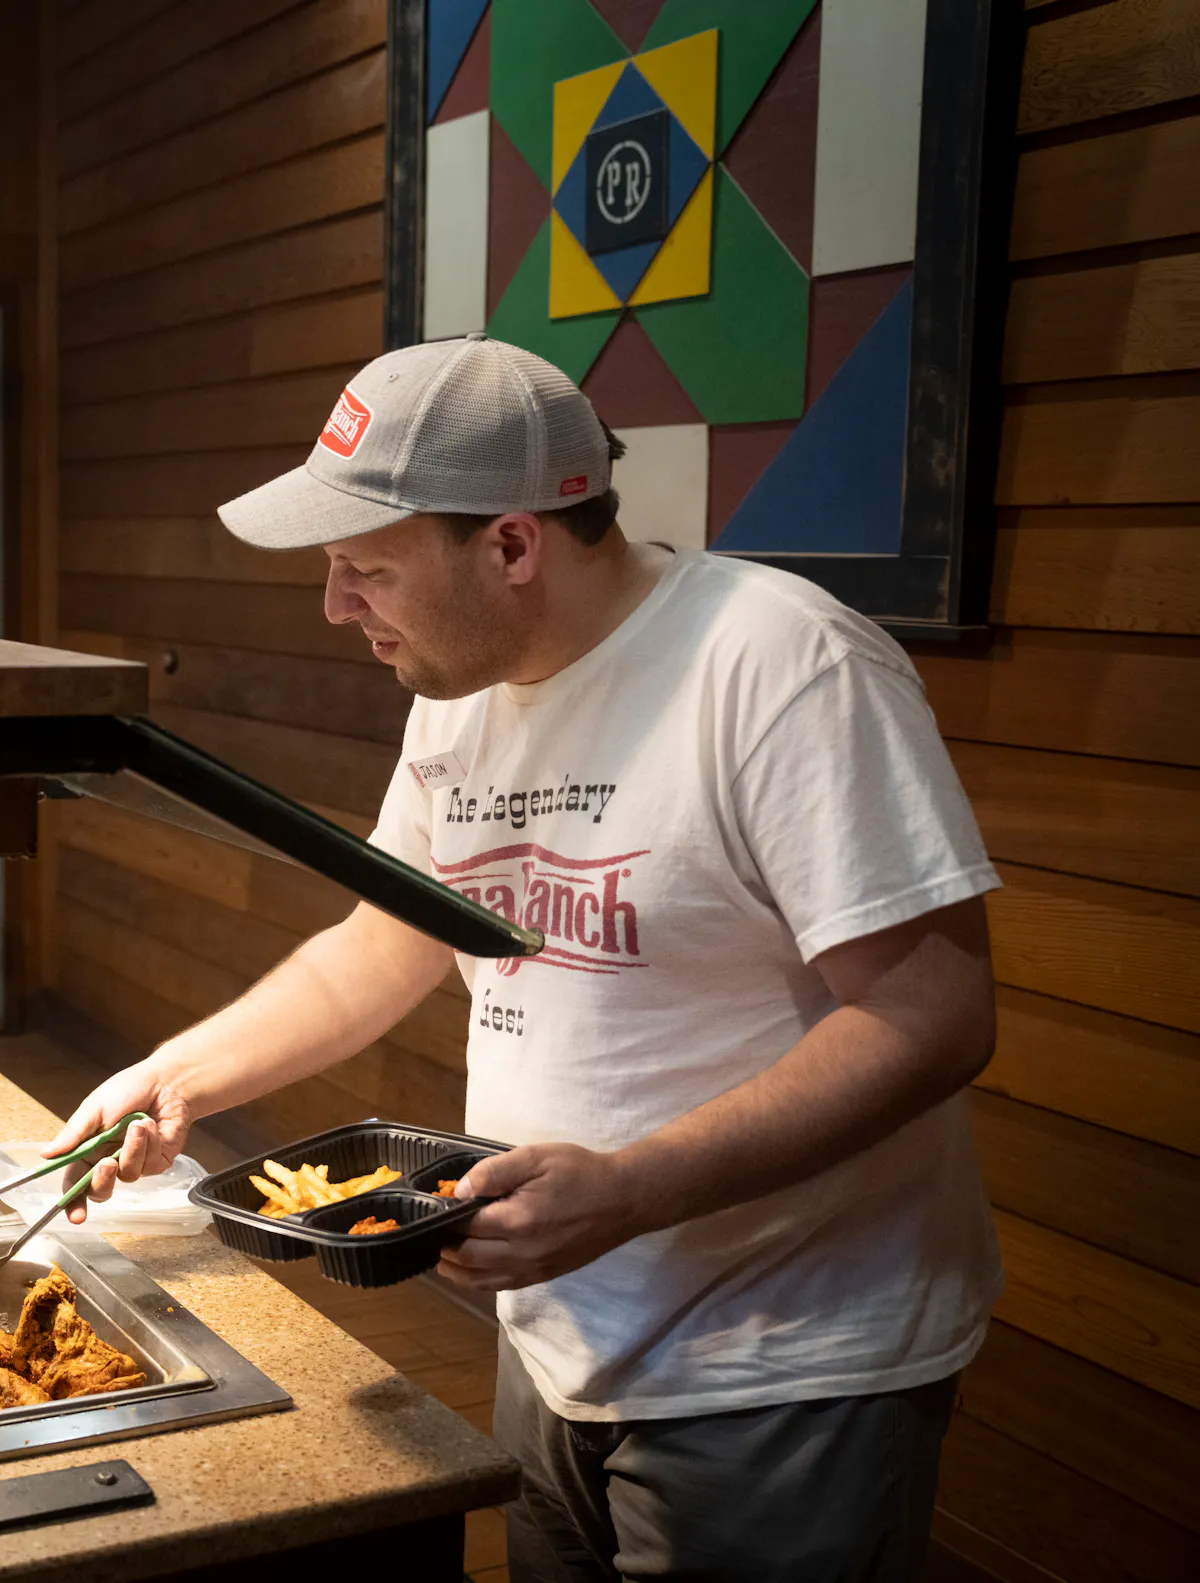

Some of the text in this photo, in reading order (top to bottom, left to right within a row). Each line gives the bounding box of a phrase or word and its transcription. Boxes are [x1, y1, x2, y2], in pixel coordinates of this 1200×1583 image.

[419, 762, 448, 780] JASON
[480, 773, 617, 829] Legendary
[518, 861, 640, 957] anch
